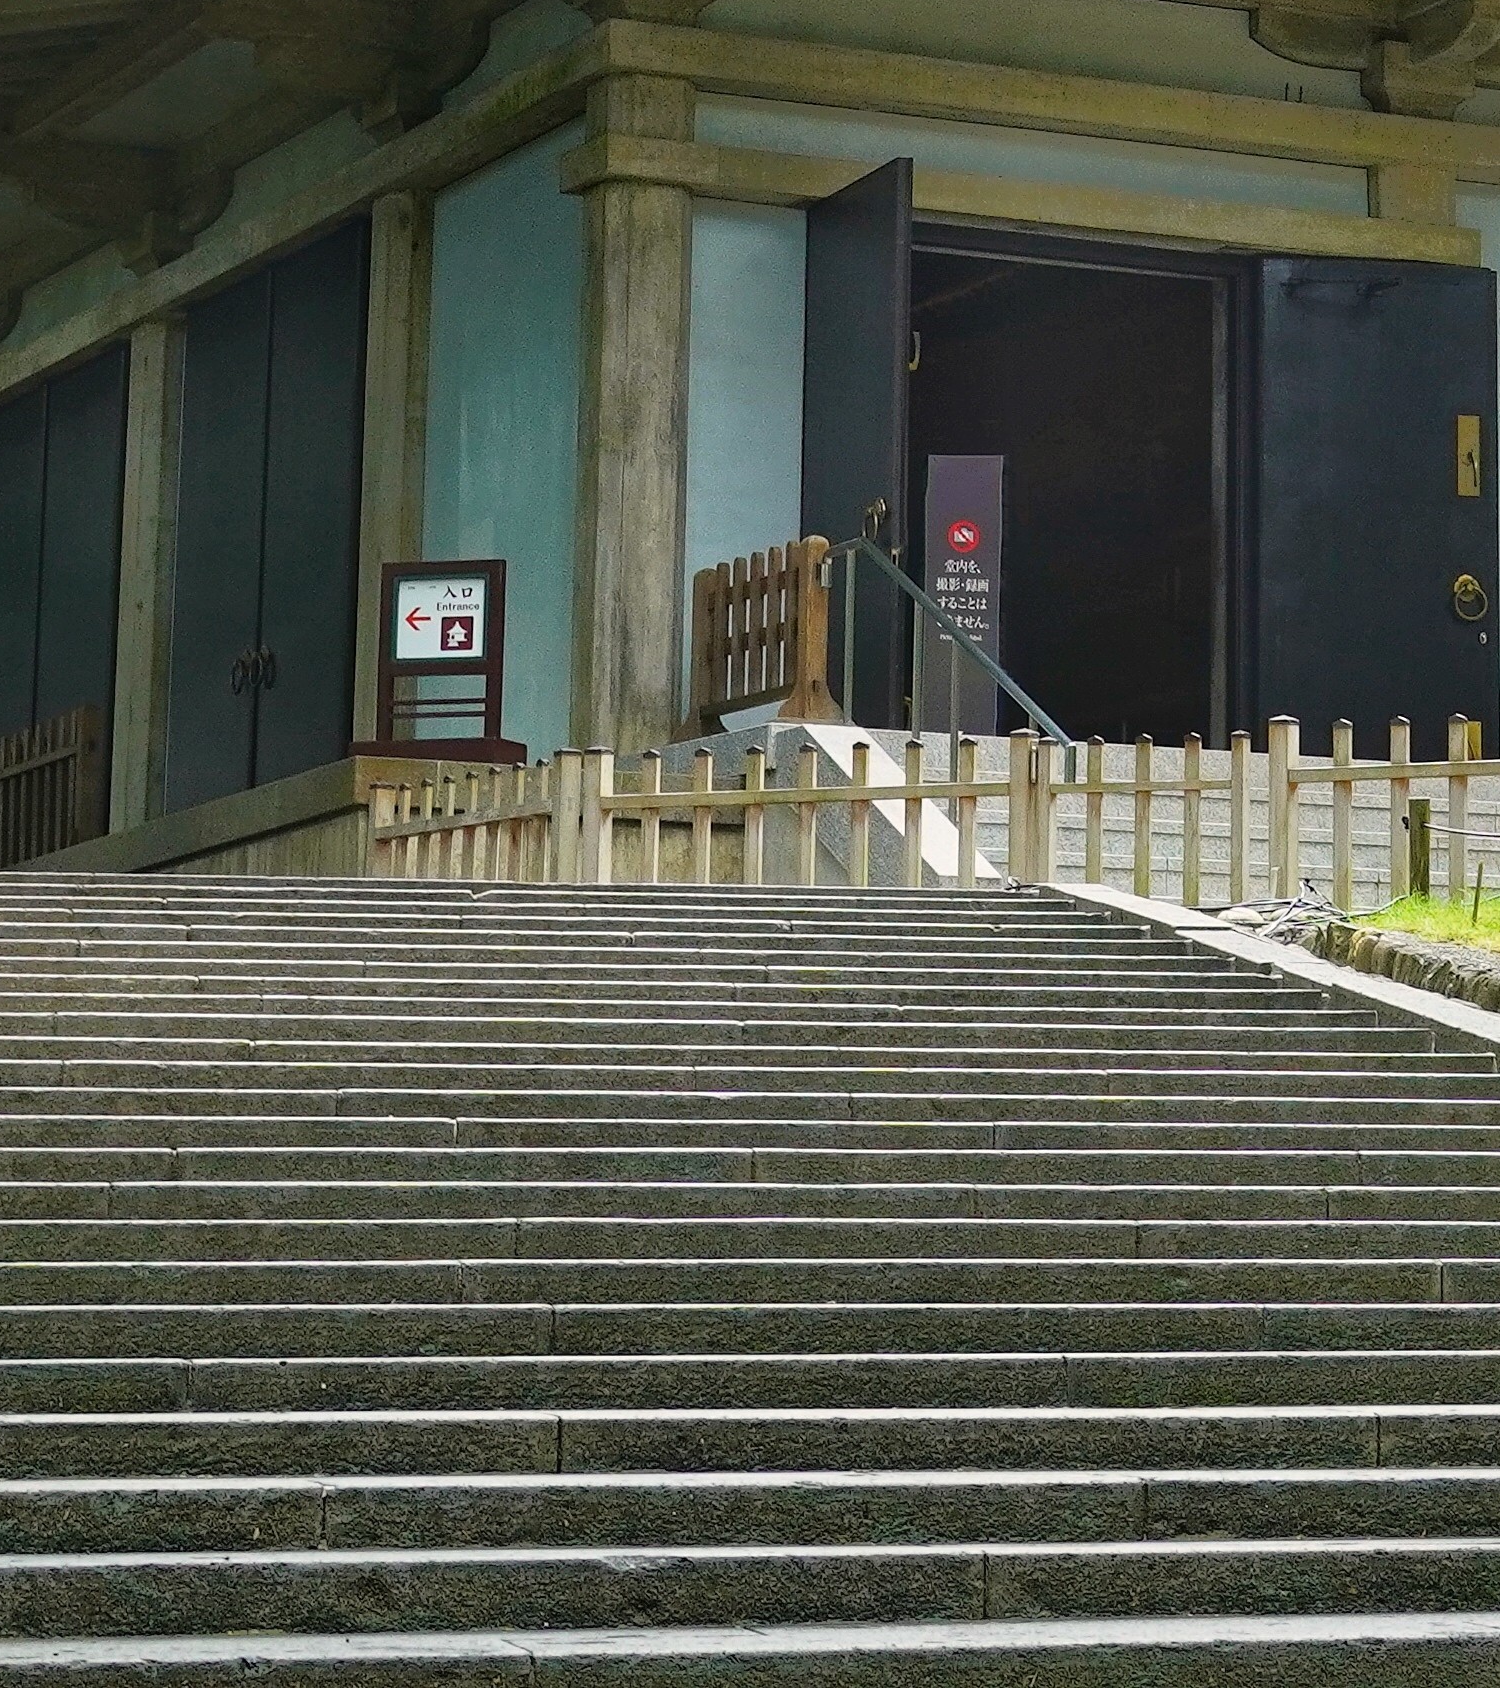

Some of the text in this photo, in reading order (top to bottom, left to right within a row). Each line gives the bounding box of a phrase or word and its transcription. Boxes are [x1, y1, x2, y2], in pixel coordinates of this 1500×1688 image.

[443, 585, 473, 598] 入口
[936, 577, 989, 592] 撮影・録画
[436, 602, 480, 611] Entrance
[937, 596, 987, 610] することは
[937, 614, 989, 629] ません。
